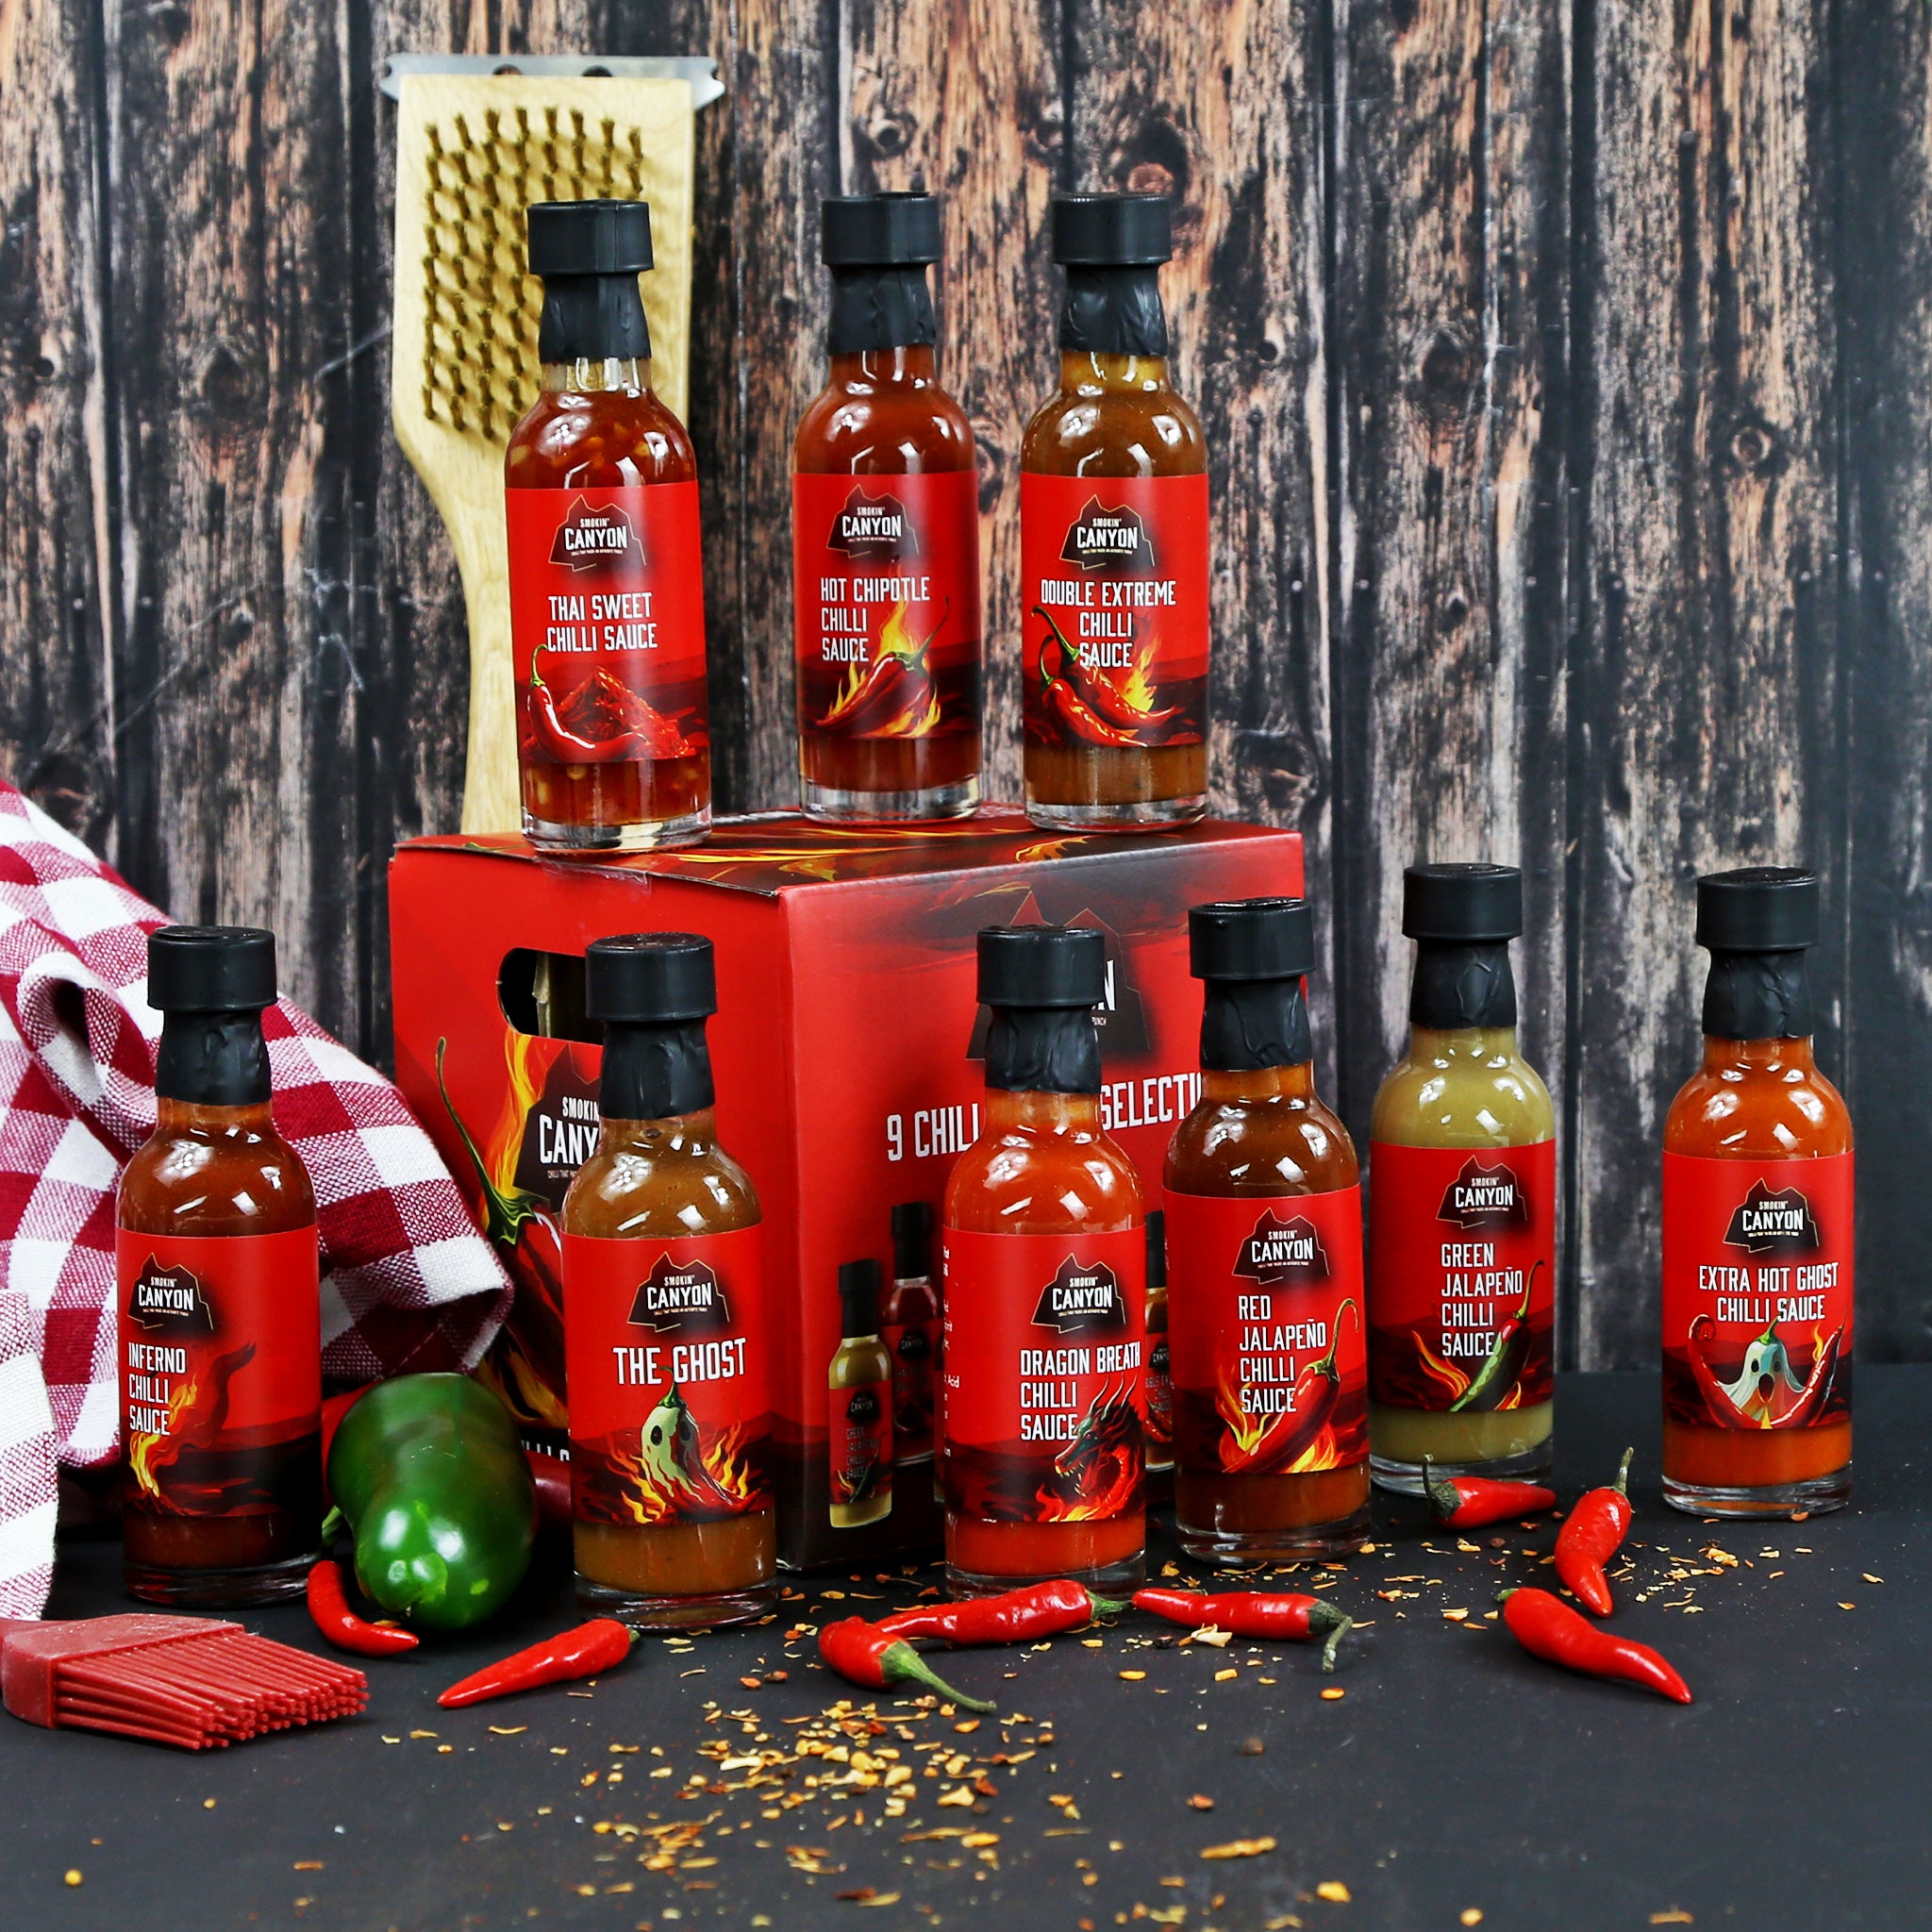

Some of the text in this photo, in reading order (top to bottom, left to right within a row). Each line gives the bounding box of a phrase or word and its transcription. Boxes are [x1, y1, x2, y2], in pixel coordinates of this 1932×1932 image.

[564, 525, 627, 550] CANYON
[842, 515, 901, 537] CANYON
[1076, 526, 1138, 549] CANYON
[821, 576, 930, 602] HOT CHIPOTLE
[1041, 579, 1176, 607] DOUBLE EXTREME
[548, 592, 652, 621] THAI SWEET
[821, 608, 867, 632] CHILLI
[1079, 611, 1131, 637] CHILLI
[547, 623, 658, 652] CHILLI SAUCE
[822, 638, 869, 661] SAUCE
[1079, 642, 1132, 668] SAUCE
[539, 1114, 599, 1166] CANY
[887, 1114, 903, 1161] 9
[1455, 1184, 1513, 1208] CANYON
[1742, 1208, 1804, 1232] CANYON
[1251, 1238, 1313, 1263] CANYON
[1441, 1243, 1494, 1267] GREEN
[1441, 1266, 1523, 1297] JALAPEÑO
[1699, 1262, 1839, 1292] EXTRA HOT GHOST
[138, 1284, 194, 1311] CANYON
[647, 1282, 712, 1310] CANYON
[1052, 1284, 1112, 1311] CANYON
[1238, 1295, 1271, 1320] RED
[1717, 1294, 1825, 1323] CHILLI SAUCE
[1441, 1302, 1493, 1326] CHILLI
[1239, 1319, 1326, 1351] JALAPEÑO
[1441, 1332, 1495, 1357] SAUCE
[128, 1341, 186, 1374] INFERNO
[612, 1337, 746, 1385] THE GHOST
[1020, 1341, 1141, 1375] DRAGON BREATH
[1240, 1356, 1294, 1382] CHILLI
[128, 1374, 170, 1404] CHILLI
[1020, 1382, 1077, 1408] CHILLI
[1241, 1387, 1297, 1413] SAUCE
[129, 1405, 171, 1436] SAUCE
[1021, 1414, 1078, 1441] SAUCE
